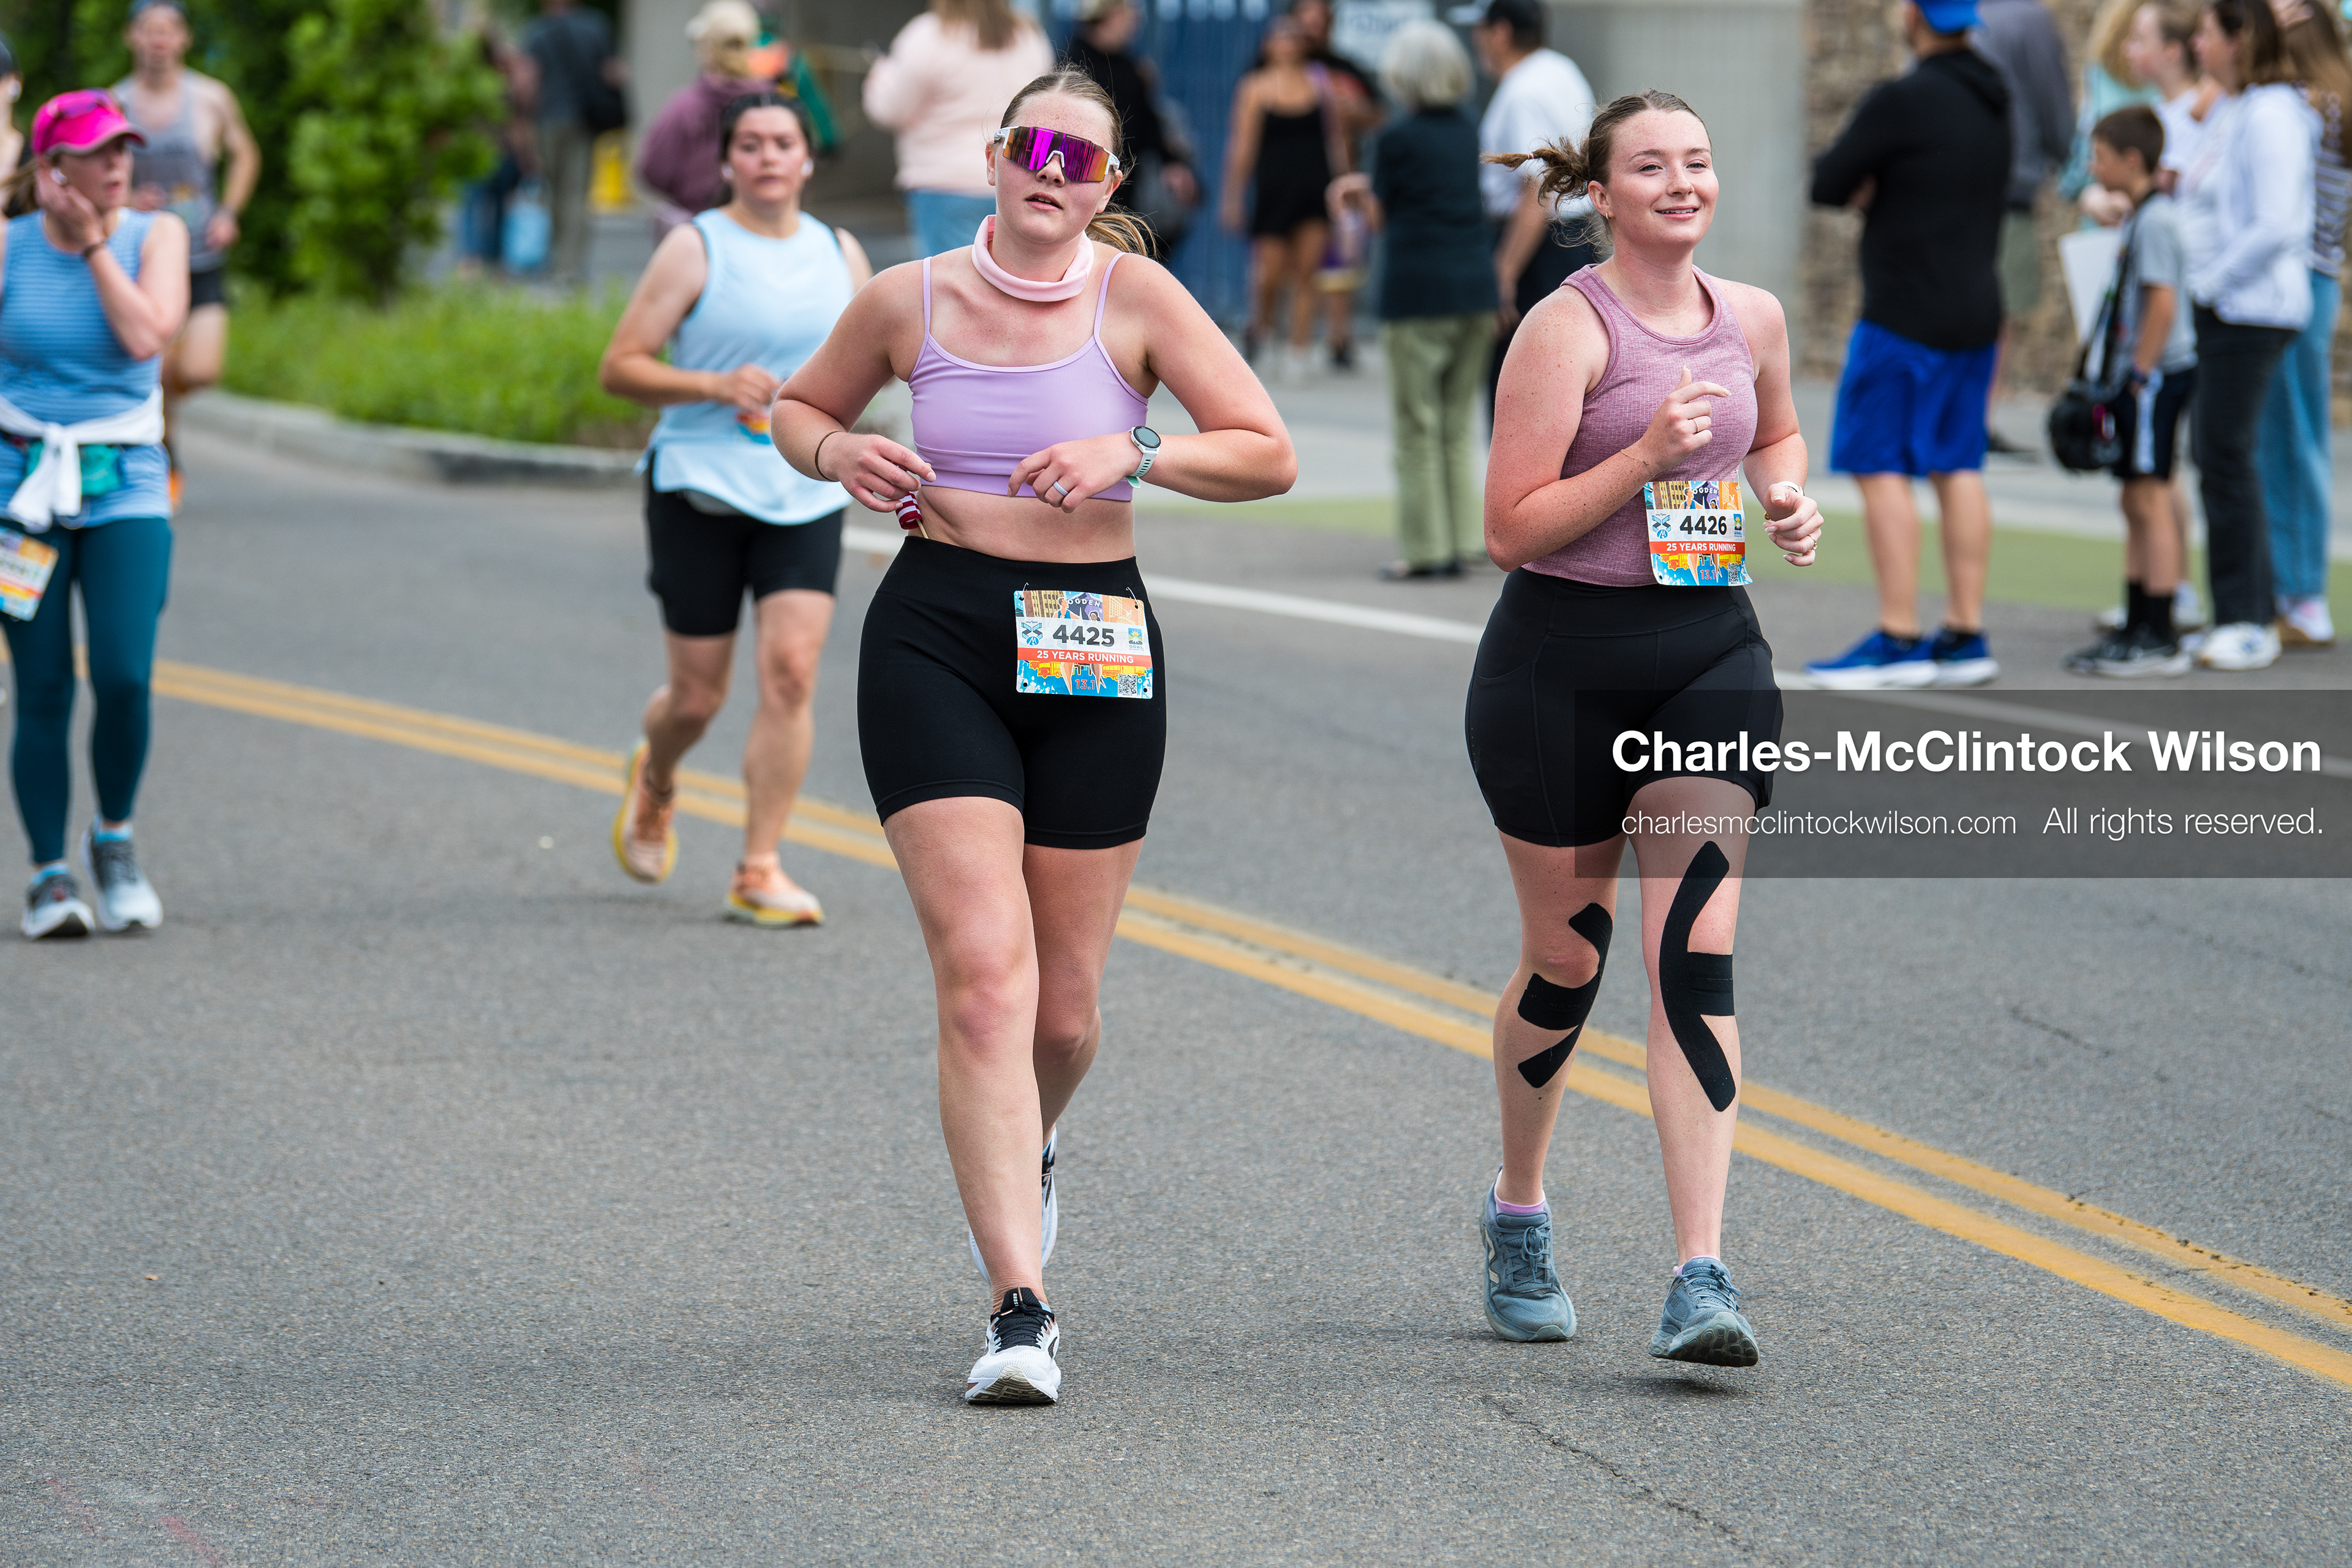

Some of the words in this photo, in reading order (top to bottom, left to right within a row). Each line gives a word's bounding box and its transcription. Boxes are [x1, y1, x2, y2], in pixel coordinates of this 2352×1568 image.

[1679, 516, 1727, 535] 4426
[1700, 570, 1716, 579] 13.1
[1068, 598, 1101, 607] OGDEN
[1052, 624, 1115, 647] 4425
[1036, 650, 1049, 658] 25
[1051, 651, 1085, 660] YEARS
[1088, 653, 1134, 663] RUNNING
[1075, 679, 1095, 690] 13.1
